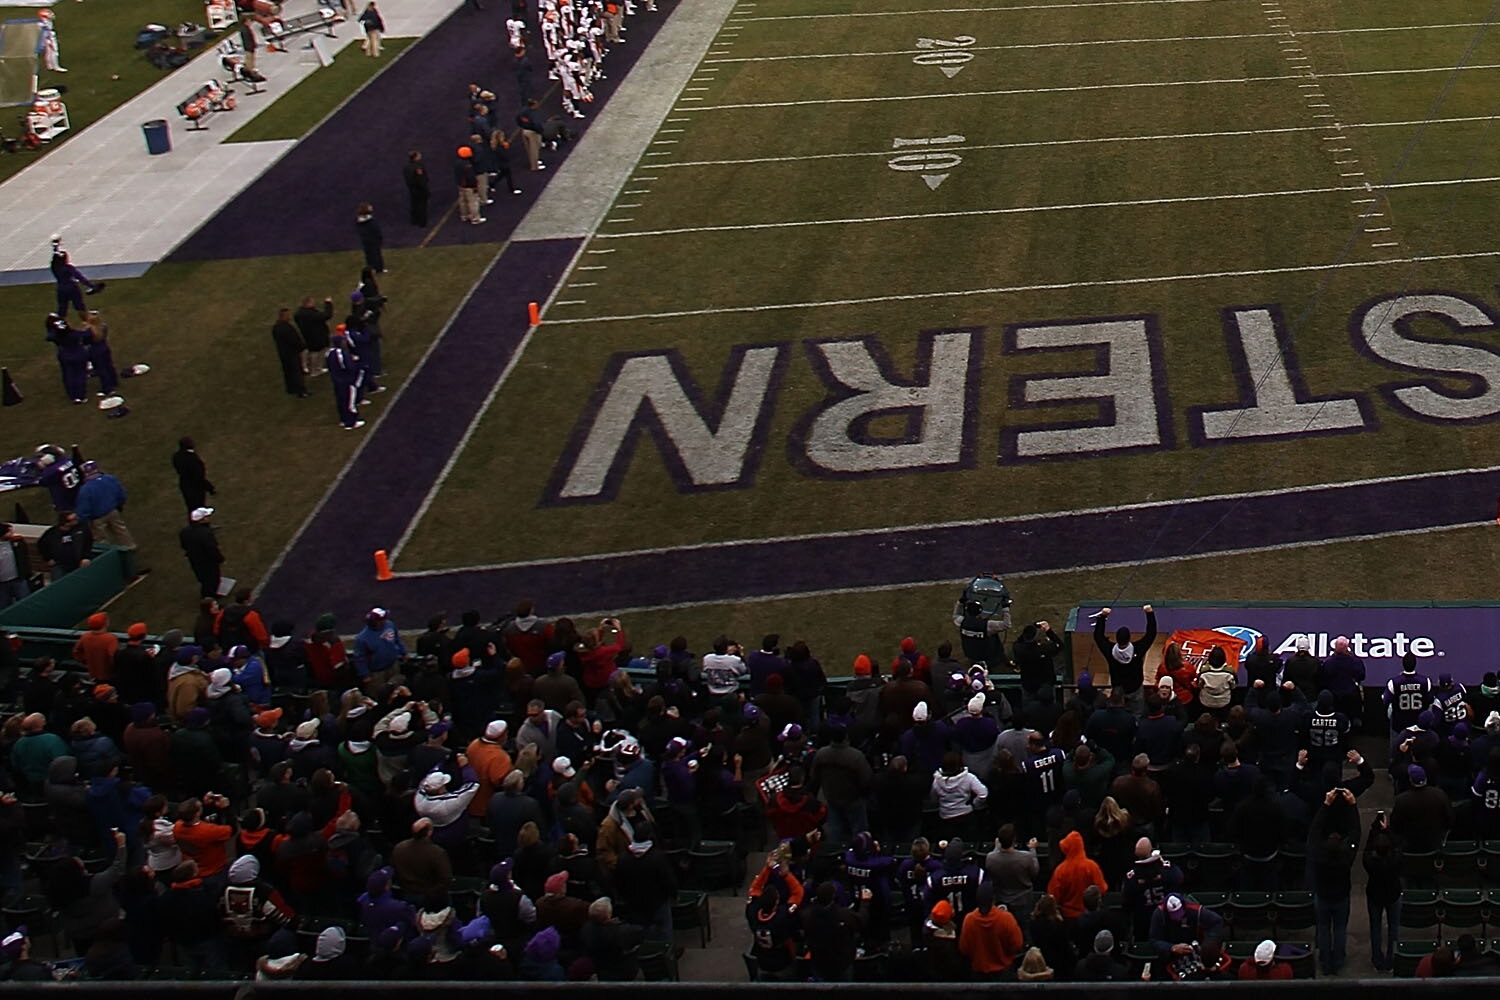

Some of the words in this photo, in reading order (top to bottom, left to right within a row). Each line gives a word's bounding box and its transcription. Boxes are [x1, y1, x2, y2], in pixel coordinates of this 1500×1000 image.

[912, 35, 977, 65] 20
[888, 135, 966, 171] 10
[1399, 693, 1423, 711] 86
[1311, 718, 1338, 728] CARTER
[1033, 754, 1058, 769] EBERT
[1039, 771, 1056, 794] 11
[847, 866, 872, 879] EBERT
[941, 874, 968, 887] EBERT
